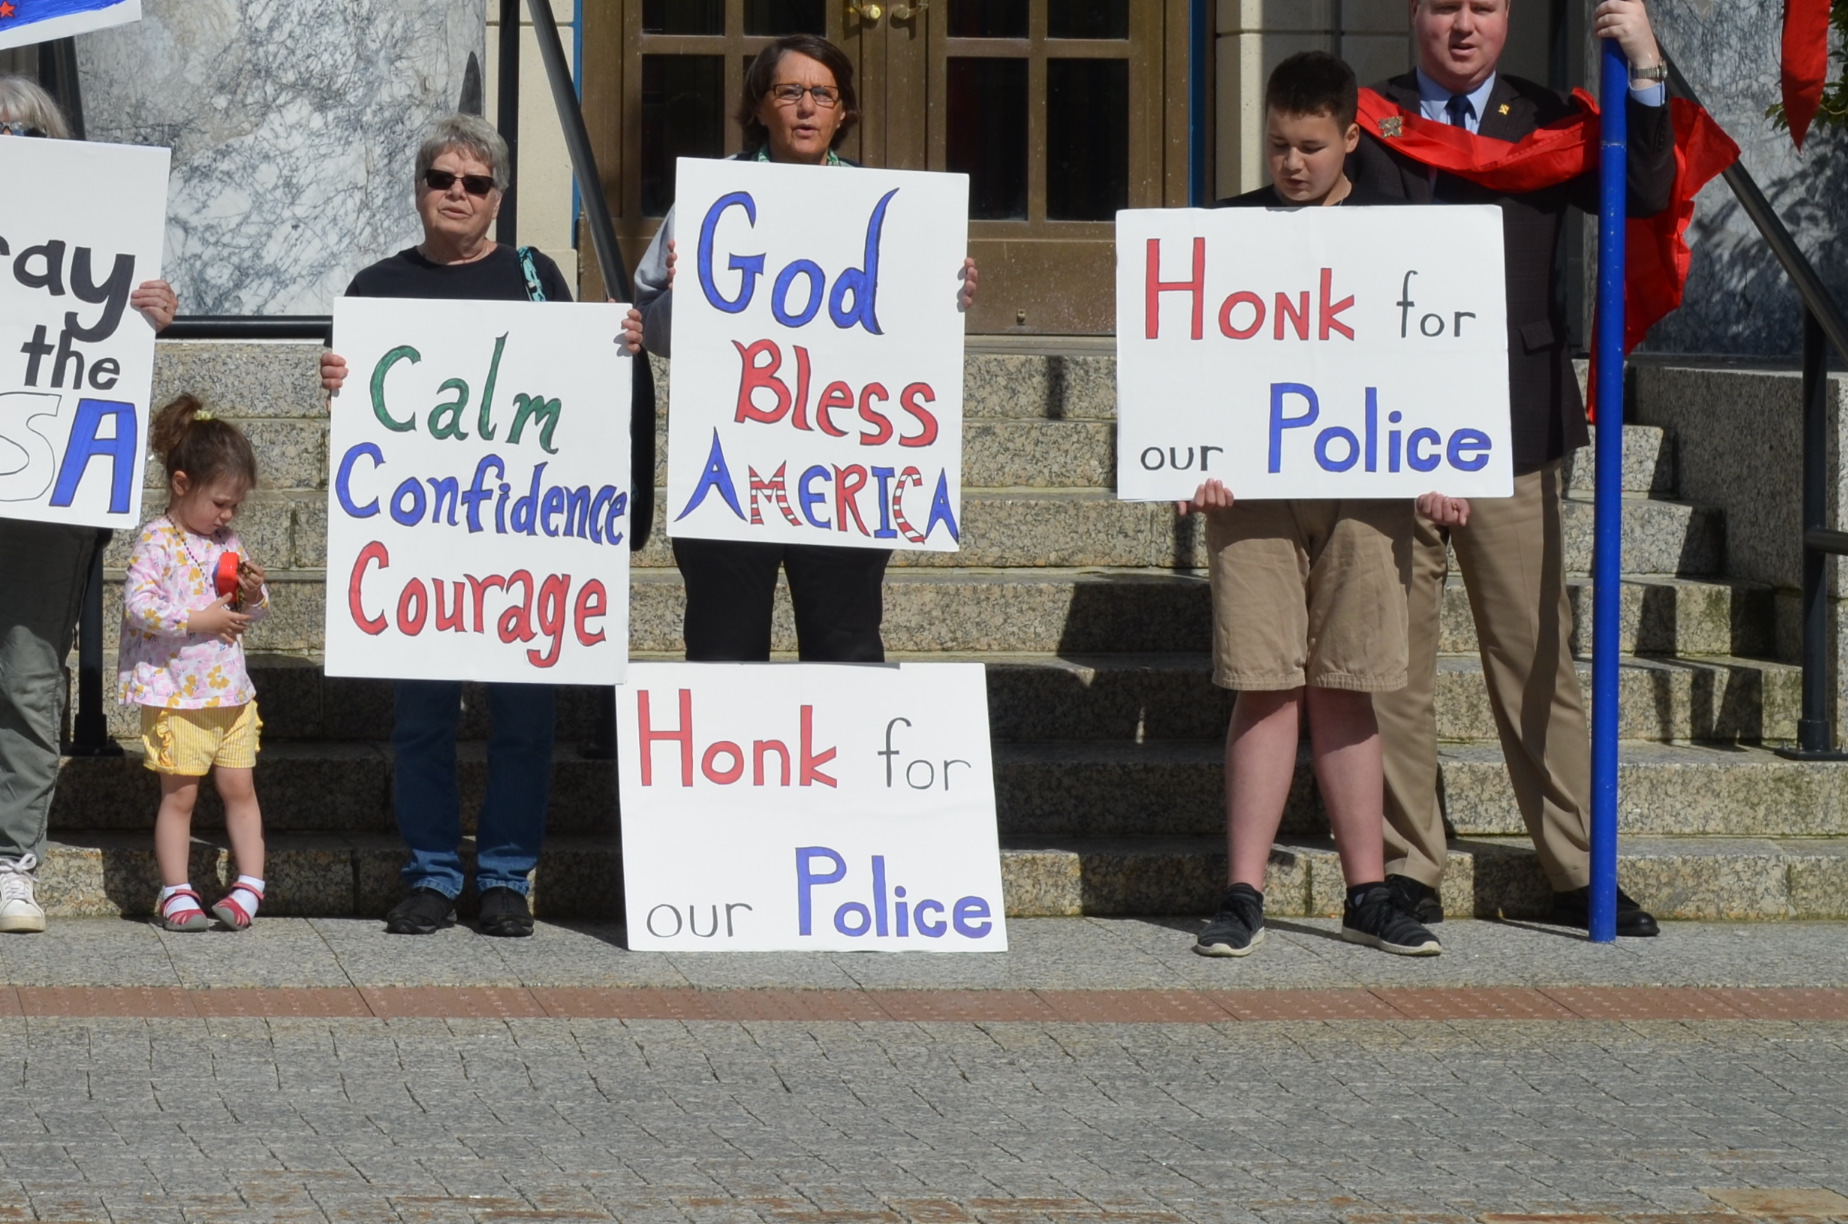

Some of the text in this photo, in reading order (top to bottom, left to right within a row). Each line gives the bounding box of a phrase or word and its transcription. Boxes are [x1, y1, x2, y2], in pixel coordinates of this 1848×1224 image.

[697, 188, 899, 335] God
[1396, 270, 1476, 338] for
[20, 324, 120, 390] the
[369, 332, 562, 454] Calm
[731, 339, 938, 448] Bless
[1141, 382, 1492, 473] our Police
[335, 442, 627, 545] Confidence
[674, 428, 961, 544] AMERICA
[348, 541, 607, 668] Courage
[637, 689, 971, 790] Honk for
[647, 846, 992, 938] our Police
